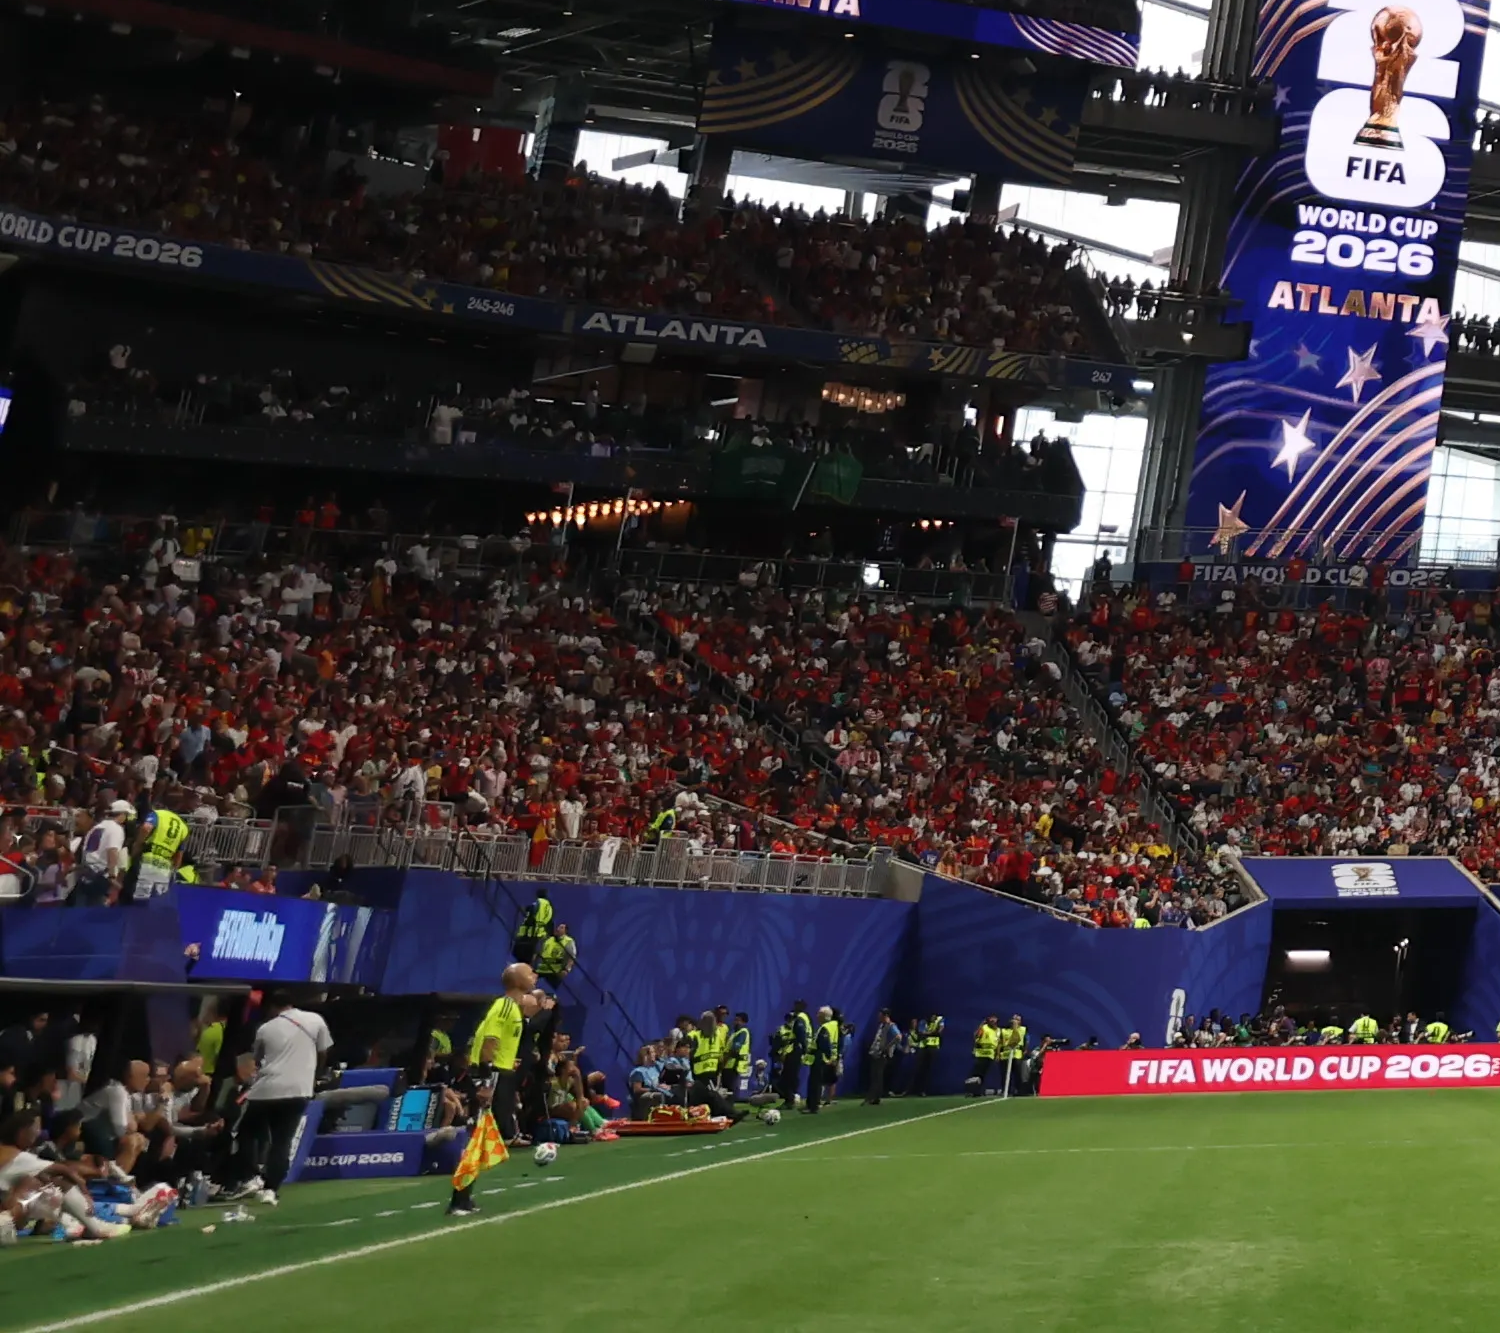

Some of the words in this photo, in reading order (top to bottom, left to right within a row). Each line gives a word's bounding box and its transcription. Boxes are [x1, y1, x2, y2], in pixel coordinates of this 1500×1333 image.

[1346, 156, 1406, 185] FIFA
[1299, 205, 1387, 234] WORLD
[1390, 213, 1438, 239] CUP
[58, 226, 109, 253] CUP
[113, 234, 203, 268] 2026
[1290, 233, 1434, 276] 2026
[467, 296, 514, 316] 245-246
[1268, 281, 1441, 323] ATLANTA
[581, 312, 767, 349] ATLANTA
[1193, 565, 1237, 582] FIFA
[1243, 566, 1323, 583] WOD
[1383, 570, 1447, 586] 026
[1128, 1058, 1196, 1085] FIFA
[1202, 1054, 1314, 1083] WORLD
[1320, 1053, 1381, 1080] CUP
[1385, 1052, 1490, 1079] 2026
[329, 1155, 356, 1166] CUP
[358, 1152, 404, 1164] 2026
